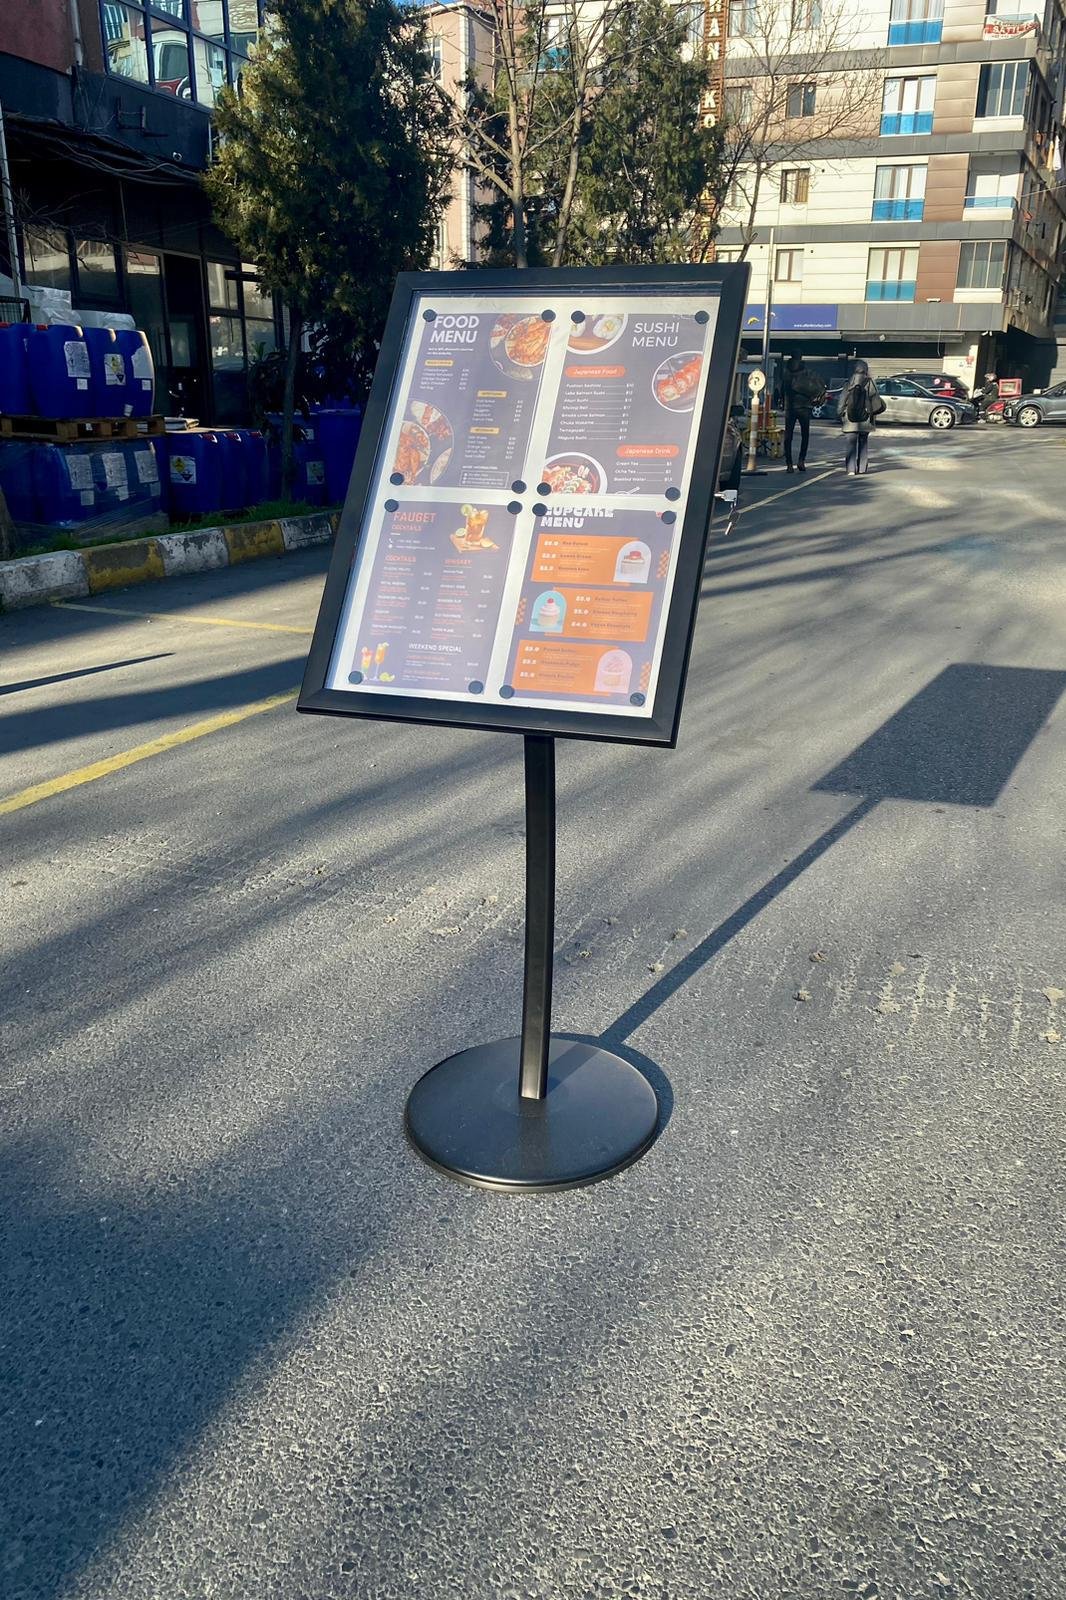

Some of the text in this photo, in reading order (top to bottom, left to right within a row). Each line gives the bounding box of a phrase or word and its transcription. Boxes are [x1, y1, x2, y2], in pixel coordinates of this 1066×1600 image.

[434, 315, 480, 329] FOOD
[633, 322, 681, 334] SUSHI
[430, 330, 478, 344] MENU
[632, 336, 679, 347] MENU
[625, 447, 653, 456] Japanese
[393, 511, 436, 523] FAUGET
[540, 517, 585, 528] MENU
[408, 642, 462, 653] WEEKEND SPECIAL
